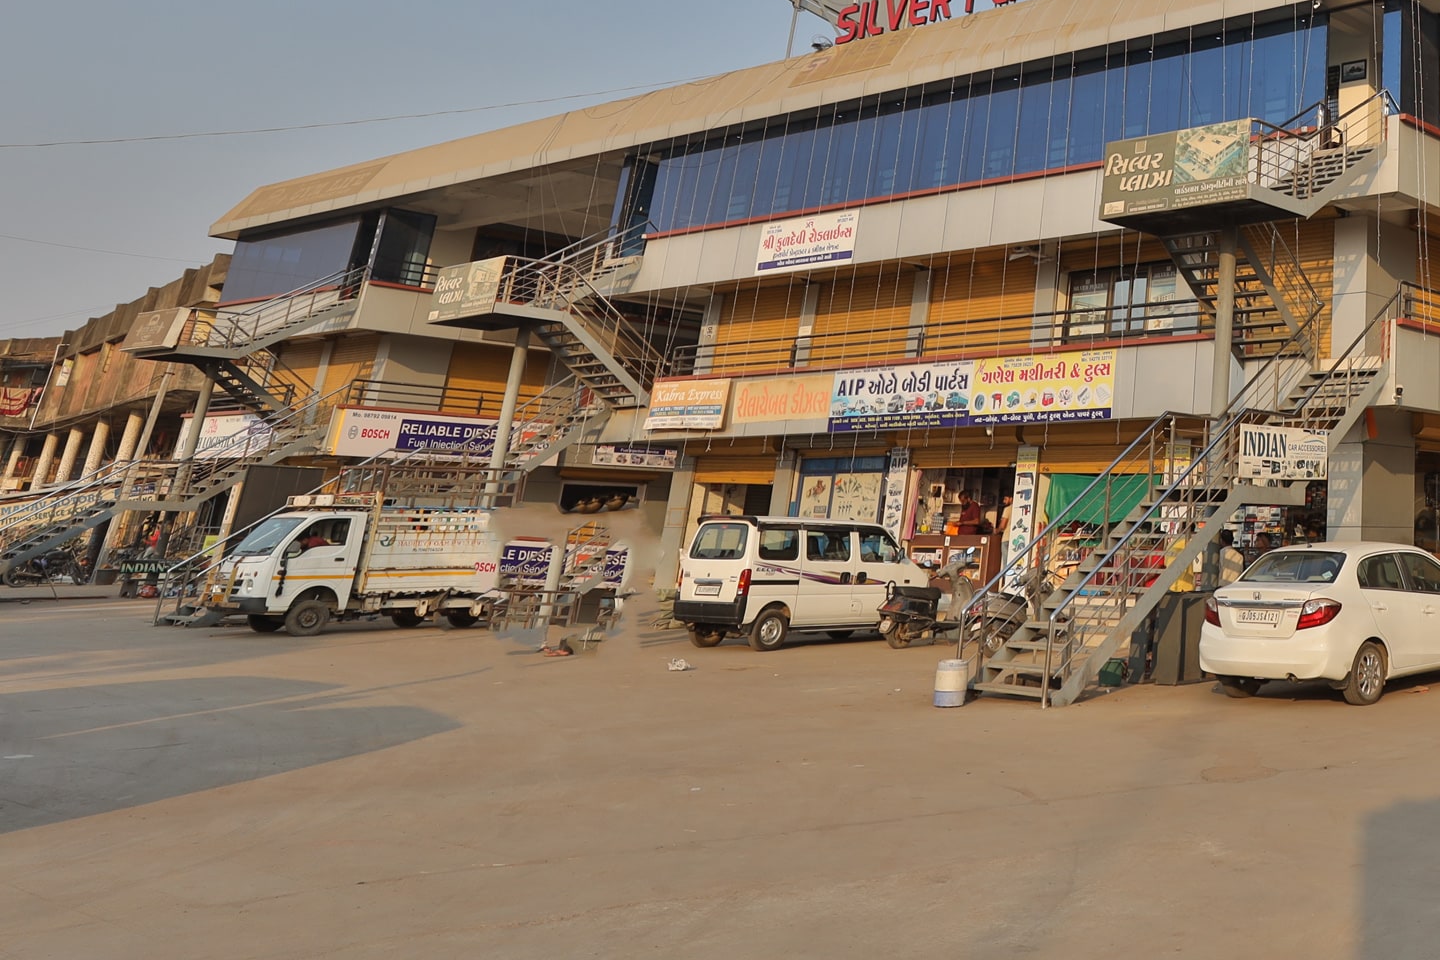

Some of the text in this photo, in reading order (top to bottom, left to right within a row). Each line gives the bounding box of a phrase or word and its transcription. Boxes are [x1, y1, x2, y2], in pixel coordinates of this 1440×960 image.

[981, 366, 1015, 384] ગણેશ
[1018, 361, 1066, 382] મશીનરી
[1070, 362, 1081, 379] &
[837, 378, 865, 397] AIP
[868, 372, 897, 395] ઓટો
[901, 370, 931, 393] બોડી
[655, 388, 724, 404] Kabra Express
[361, 428, 390, 440] BOSCH
[401, 423, 498, 441] RELIABLE DIESE
[407, 437, 428, 448] Fuel
[1243, 430, 1287, 458] INDIAN
[1288, 443, 1327, 453] CAR ACCESSORIES
[891, 457, 908, 469] AIP
[120, 562, 165, 573] INDIAN
